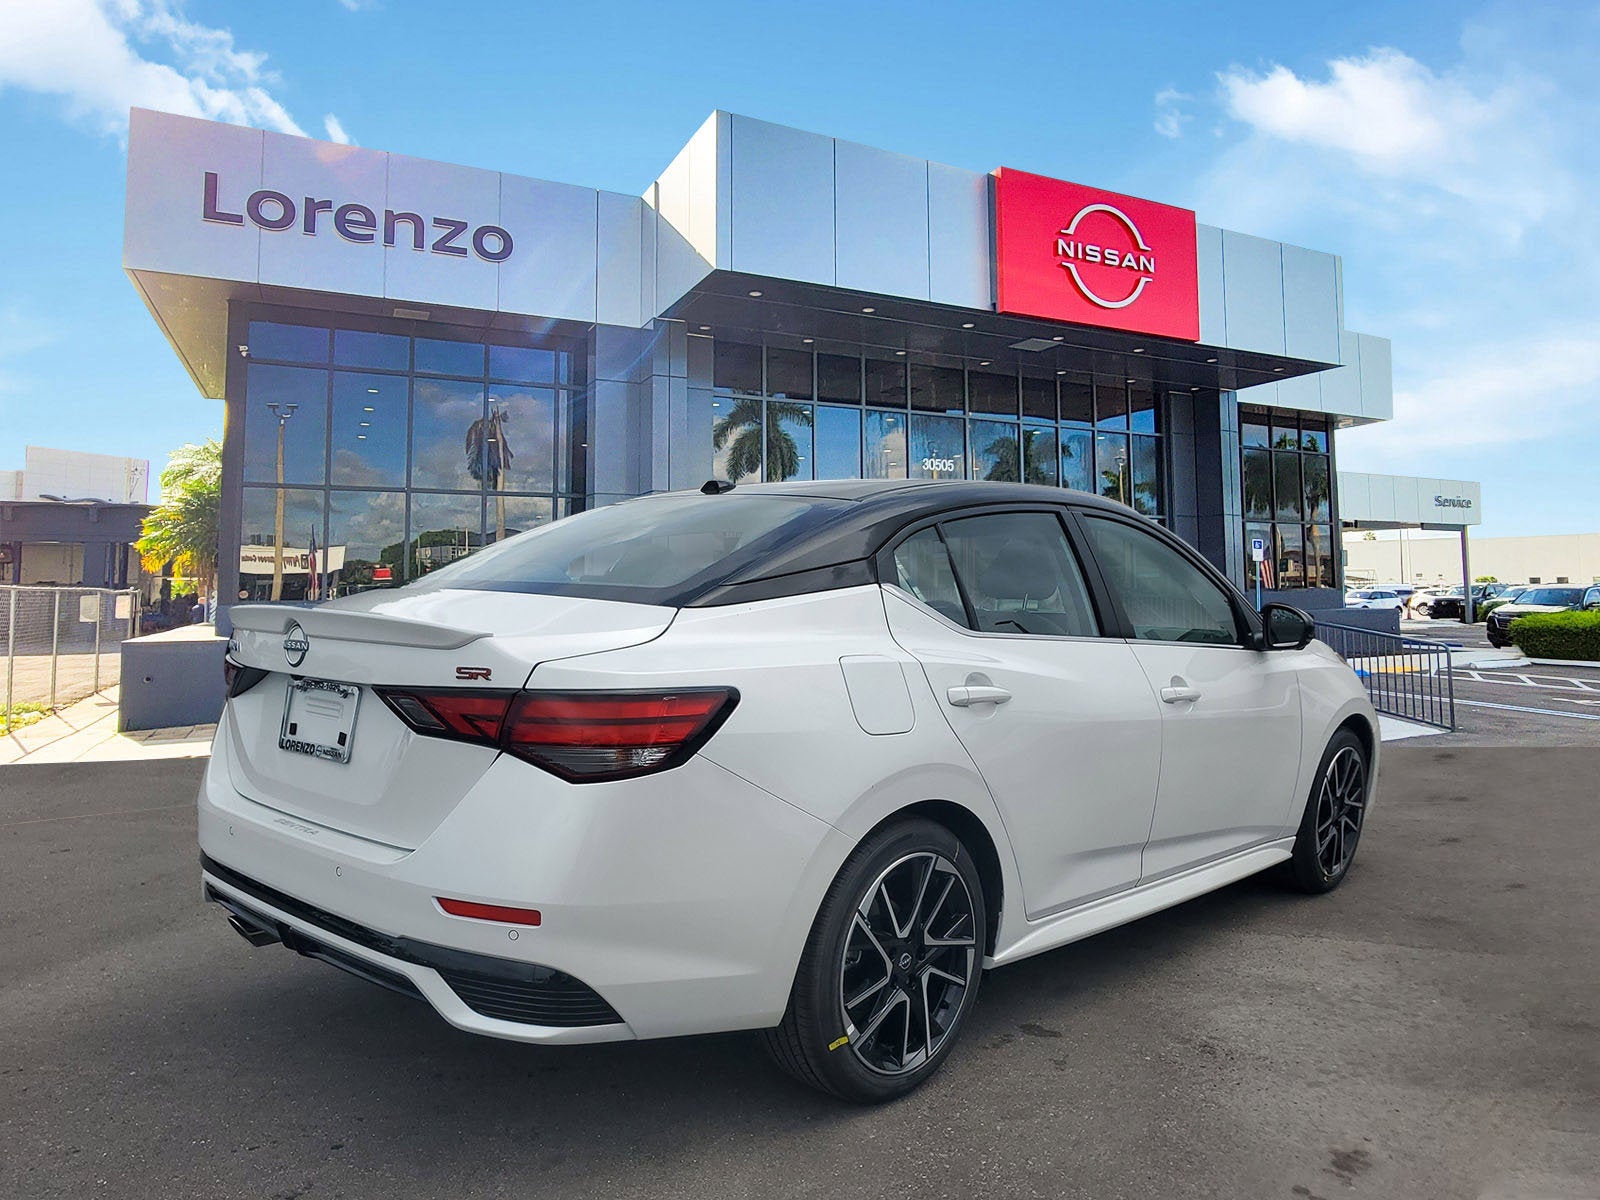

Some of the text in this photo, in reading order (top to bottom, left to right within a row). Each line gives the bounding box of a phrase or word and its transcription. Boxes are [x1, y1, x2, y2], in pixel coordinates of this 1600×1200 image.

[202, 171, 514, 262] Lorenzo
[1057, 238, 1155, 273] NISSAN
[922, 458, 954, 471] 30505
[1434, 495, 1472, 508] Service
[455, 666, 492, 681] SR
[281, 739, 316, 755] LORENZO
